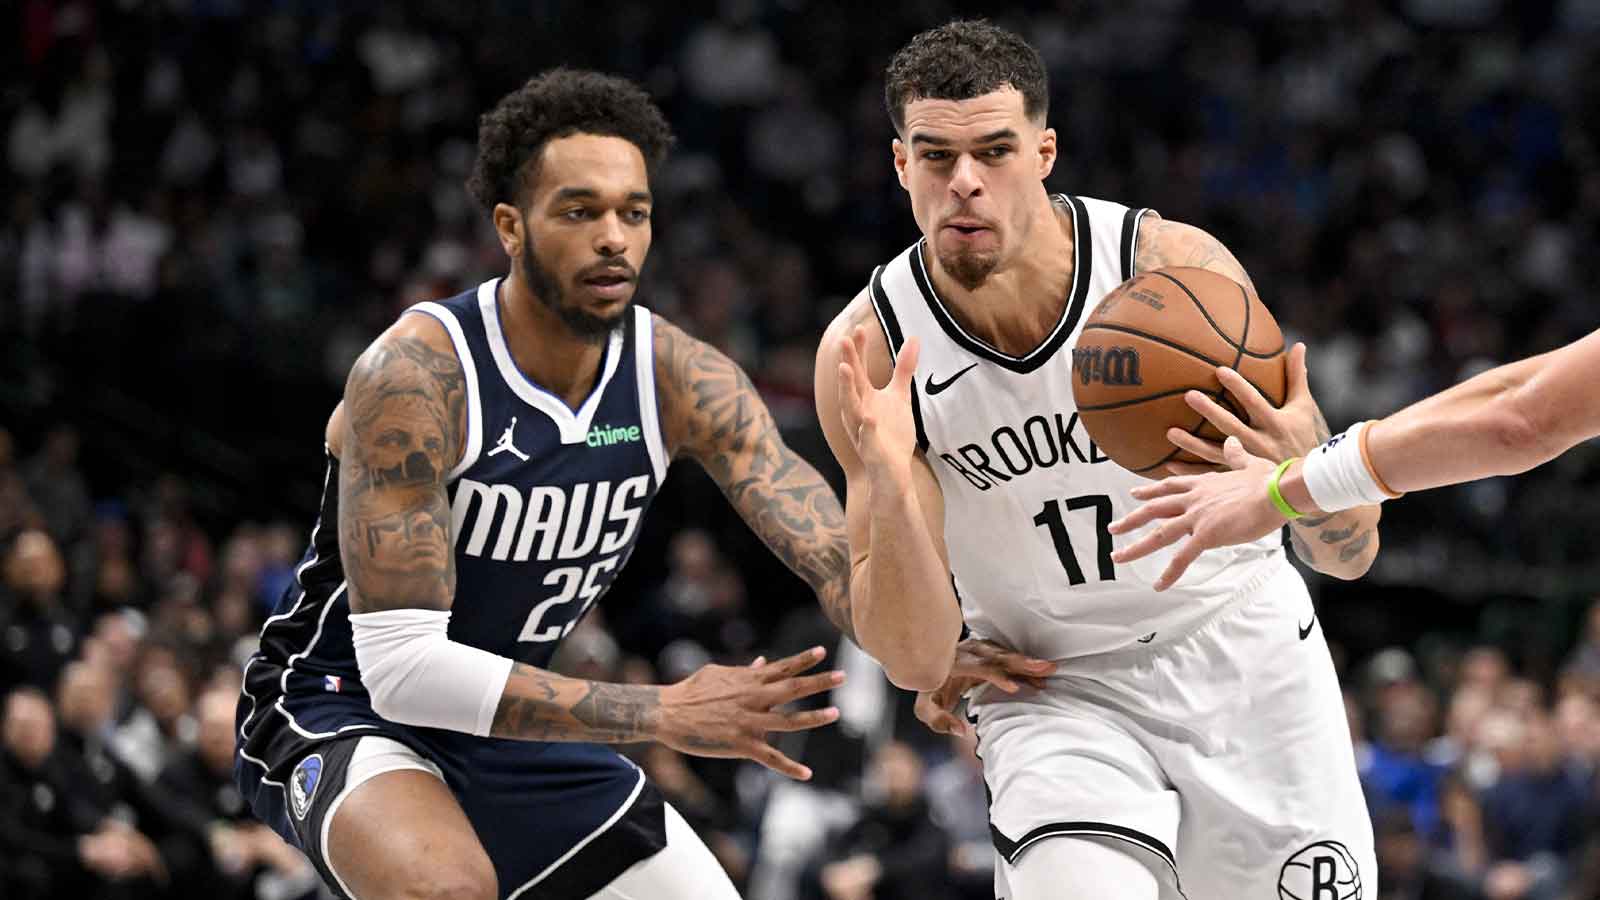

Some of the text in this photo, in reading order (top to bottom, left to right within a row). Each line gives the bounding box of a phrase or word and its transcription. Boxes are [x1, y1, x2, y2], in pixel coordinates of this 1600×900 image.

[586, 424, 640, 447] chime
[450, 475, 649, 561] MAVS
[1033, 495, 1115, 585] 17
[517, 555, 619, 642] 25
[1313, 856, 1338, 900] B
